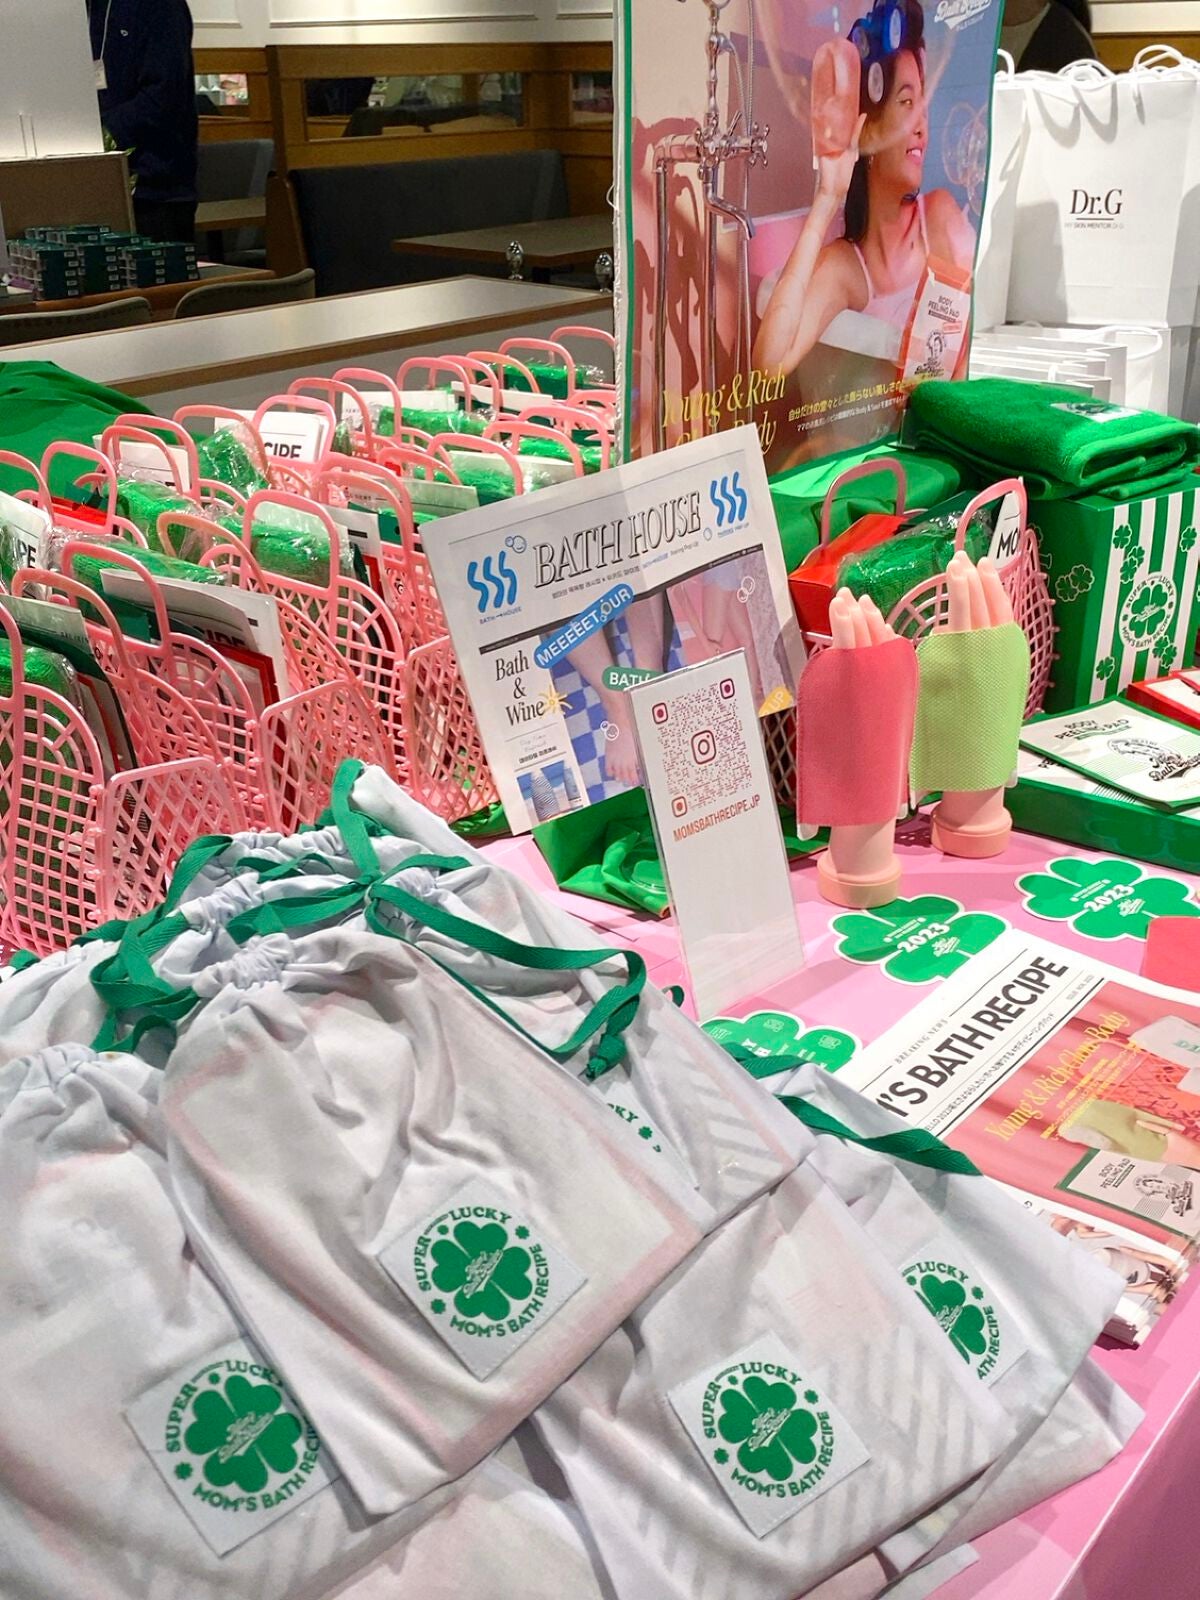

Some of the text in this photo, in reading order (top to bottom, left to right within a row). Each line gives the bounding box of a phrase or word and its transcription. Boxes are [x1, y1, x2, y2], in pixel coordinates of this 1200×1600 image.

[1069, 188, 1123, 215] Dr.G
[928, 300, 949, 315] PEELING
[949, 307, 960, 318] PAD
[938, 295, 953, 307] BODY
[726, 373, 744, 412] &
[746, 362, 786, 408] Rich
[533, 491, 701, 588] BATH HOUSE
[1126, 575, 1175, 608] SUPER LUCKY
[495, 650, 529, 682] Bath
[513, 677, 527, 699] &
[505, 698, 546, 727] Wine
[1054, 718, 1130, 740] PEELING PAD
[672, 793, 761, 842] MOMSBATHRECIPE.JP
[1083, 884, 1135, 912] 2023
[897, 922, 950, 953] 2023
[906, 1024, 995, 1088] BATH
[971, 956, 1069, 1031] RECIPE
[1085, 1011, 1130, 1042] Body
[894, 1018, 949, 1065] BREAKING NEWS
[1032, 1064, 1074, 1097] Rich
[1024, 1088, 1048, 1107] &
[984, 1100, 1044, 1141] Young
[1099, 1163, 1115, 1177] BODY
[1100, 1158, 1131, 1188] PEELING PAD
[414, 1235, 431, 1291] SUPER
[448, 1206, 512, 1224] LUCKY
[916, 1261, 969, 1283] LUCKY
[450, 1315, 506, 1338] MOM'S
[507, 1298, 544, 1333] BATH
[529, 1242, 549, 1298] RECIPE
[982, 1305, 1000, 1357] RECIPE
[702, 1381, 721, 1440] SUPER
[740, 1362, 802, 1385] LUCKY
[166, 1383, 198, 1453] SUPER
[731, 1467, 786, 1498] MOM'S
[788, 1464, 825, 1497] BATH
[817, 1411, 834, 1467] RECIPE
[192, 1483, 258, 1513] MOM'S
[261, 1473, 307, 1509] BATH
